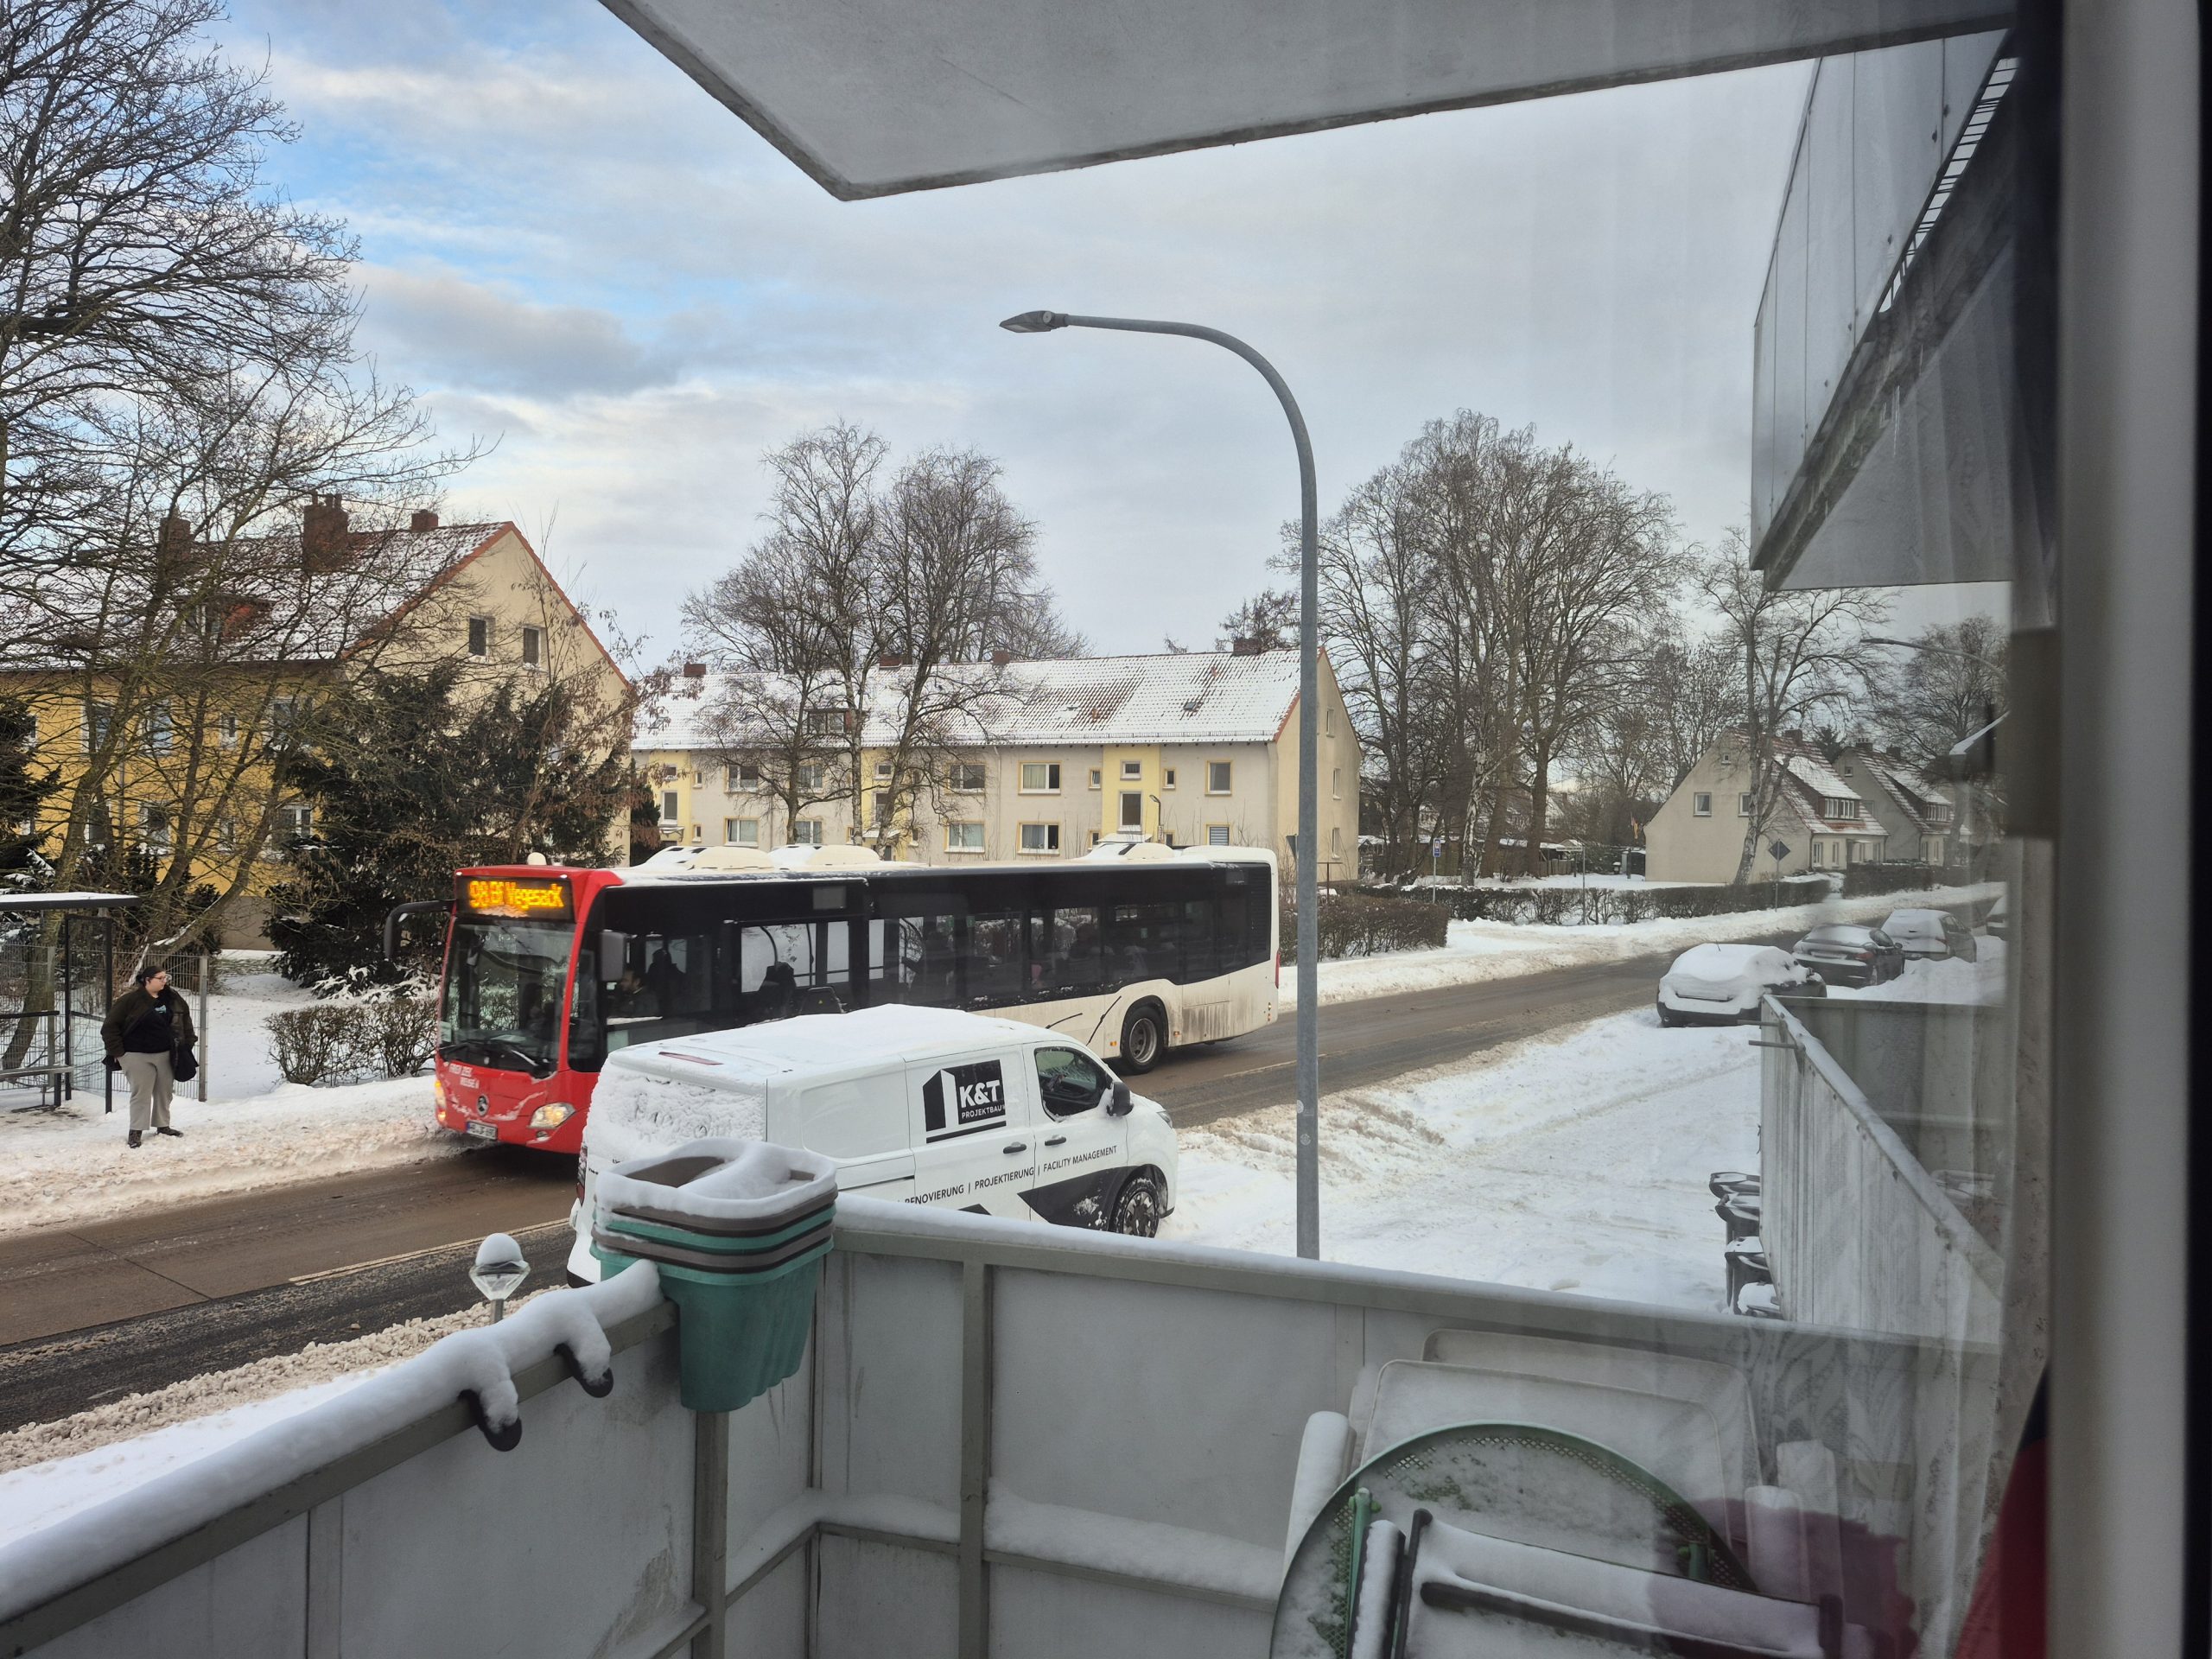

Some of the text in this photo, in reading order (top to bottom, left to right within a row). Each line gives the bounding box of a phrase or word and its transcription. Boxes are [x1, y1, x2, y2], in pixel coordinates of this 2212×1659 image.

[959, 1079, 1001, 1109] K&T
[975, 1166, 1034, 1190] PROJEKTIERUNG
[1043, 1158, 1071, 1173] FACILITY
[1072, 1145, 1117, 1165] MANAGEMENT
